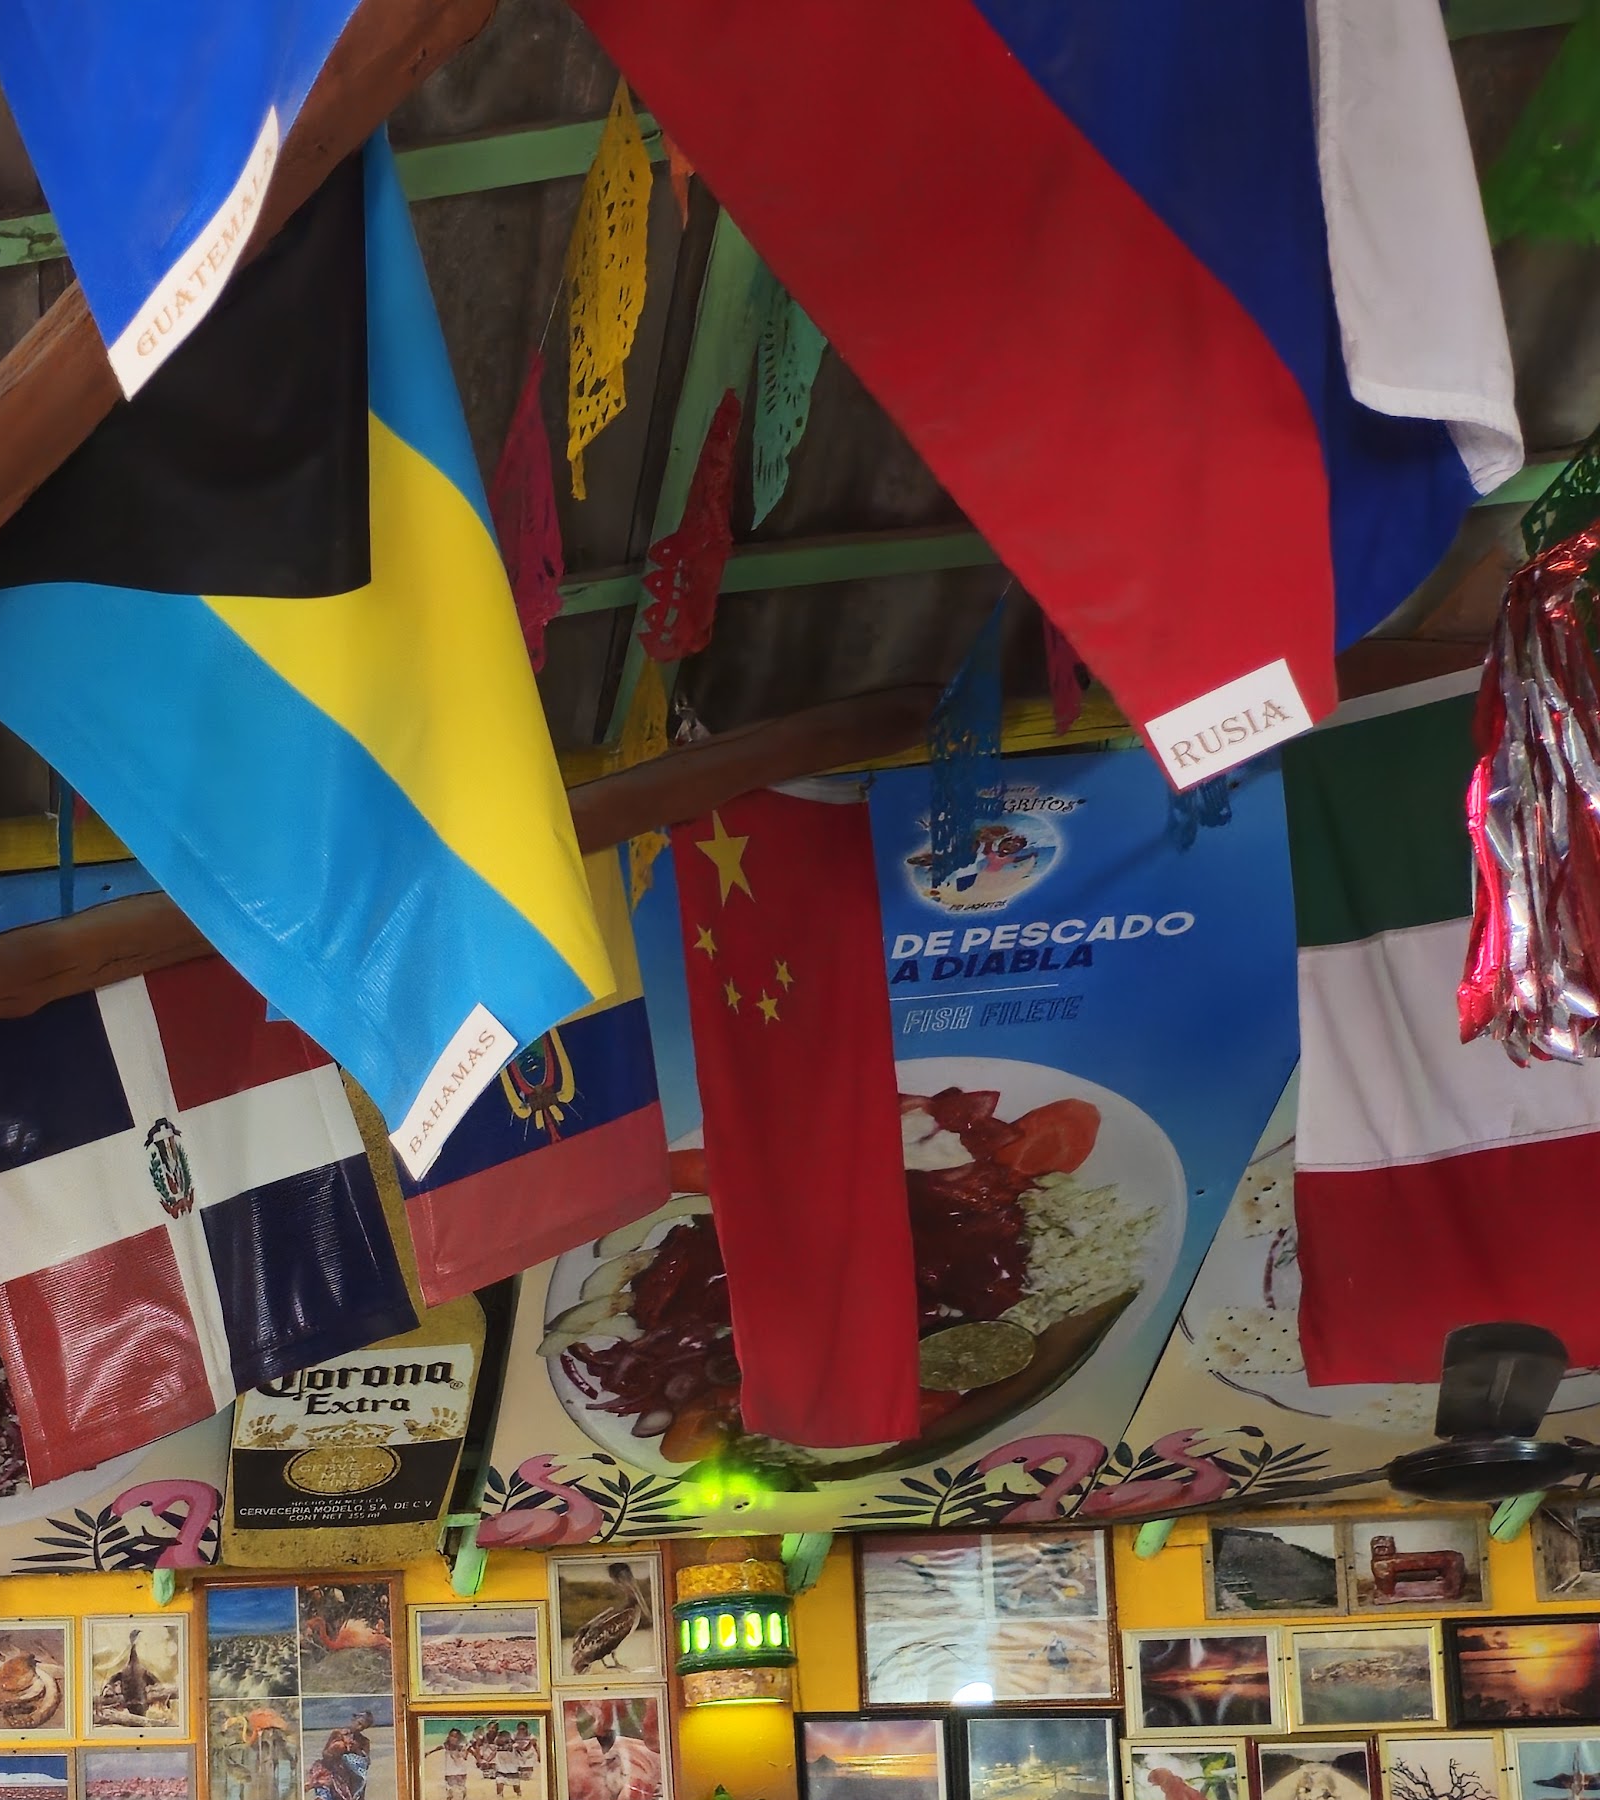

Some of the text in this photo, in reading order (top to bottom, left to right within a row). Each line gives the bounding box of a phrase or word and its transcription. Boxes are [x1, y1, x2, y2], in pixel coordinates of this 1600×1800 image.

[136, 146, 274, 357] GUATEMALA
[1169, 699, 1294, 769] RUSIA
[891, 911, 1196, 960] DE PESCADO
[890, 943, 1093, 984] A DIABLA
[903, 996, 1084, 1034] FISH FILETE
[409, 1030, 496, 1155] BAHAMAS
[255, 1361, 454, 1400] Corona
[304, 1393, 411, 1416] Extra
[239, 1506, 311, 1516] CERVECERIA
[394, 1501, 409, 1510] DE
